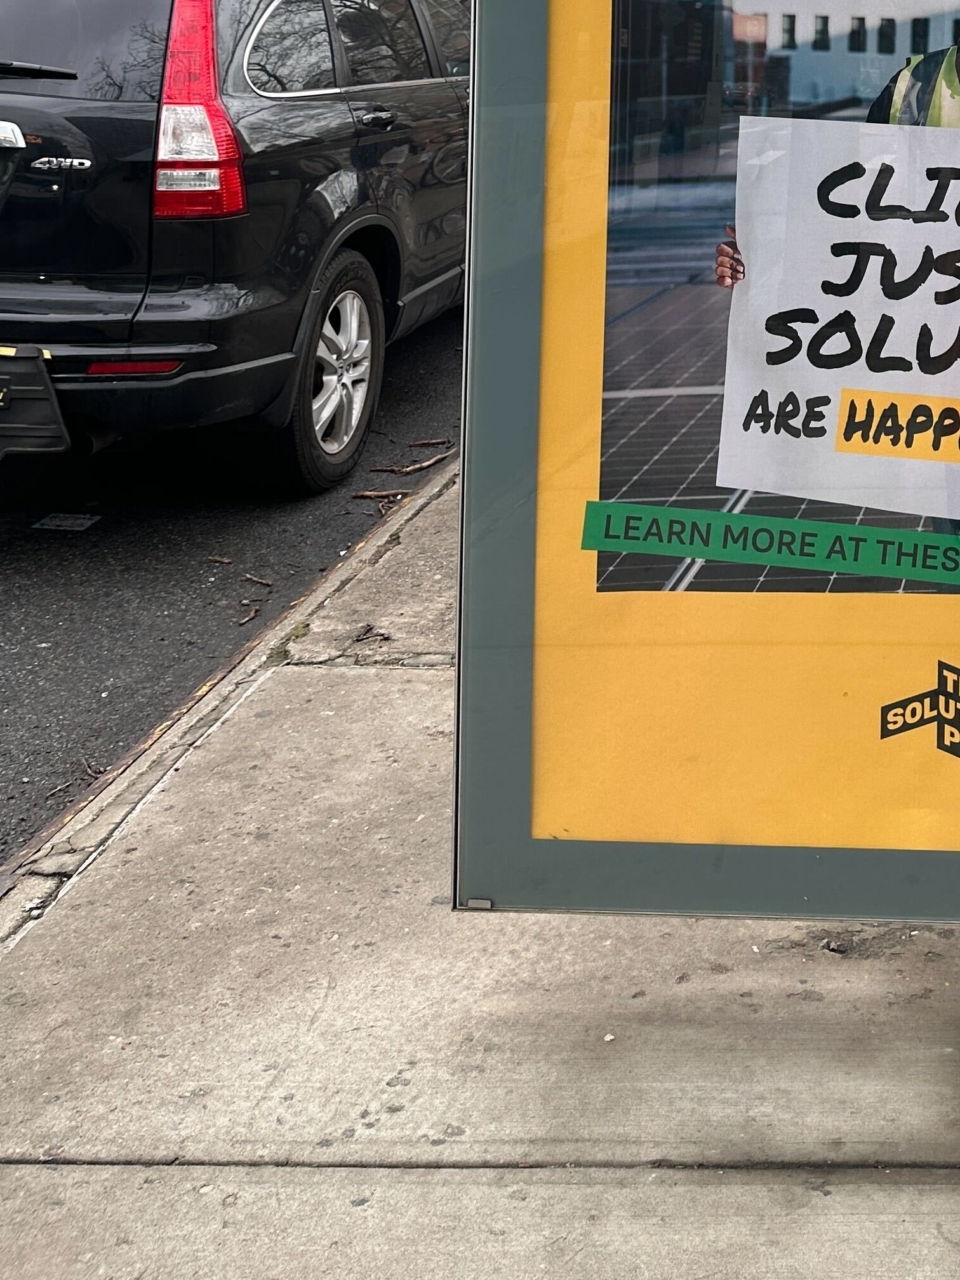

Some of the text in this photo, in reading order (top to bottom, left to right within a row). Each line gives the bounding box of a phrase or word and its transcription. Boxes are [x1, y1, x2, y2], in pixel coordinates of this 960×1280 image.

[31, 157, 92, 170] 4WD
[742, 389, 831, 438] ARE
[603, 513, 711, 548] LEARN
[722, 526, 819, 558] MORE
[826, 535, 867, 563] AT
